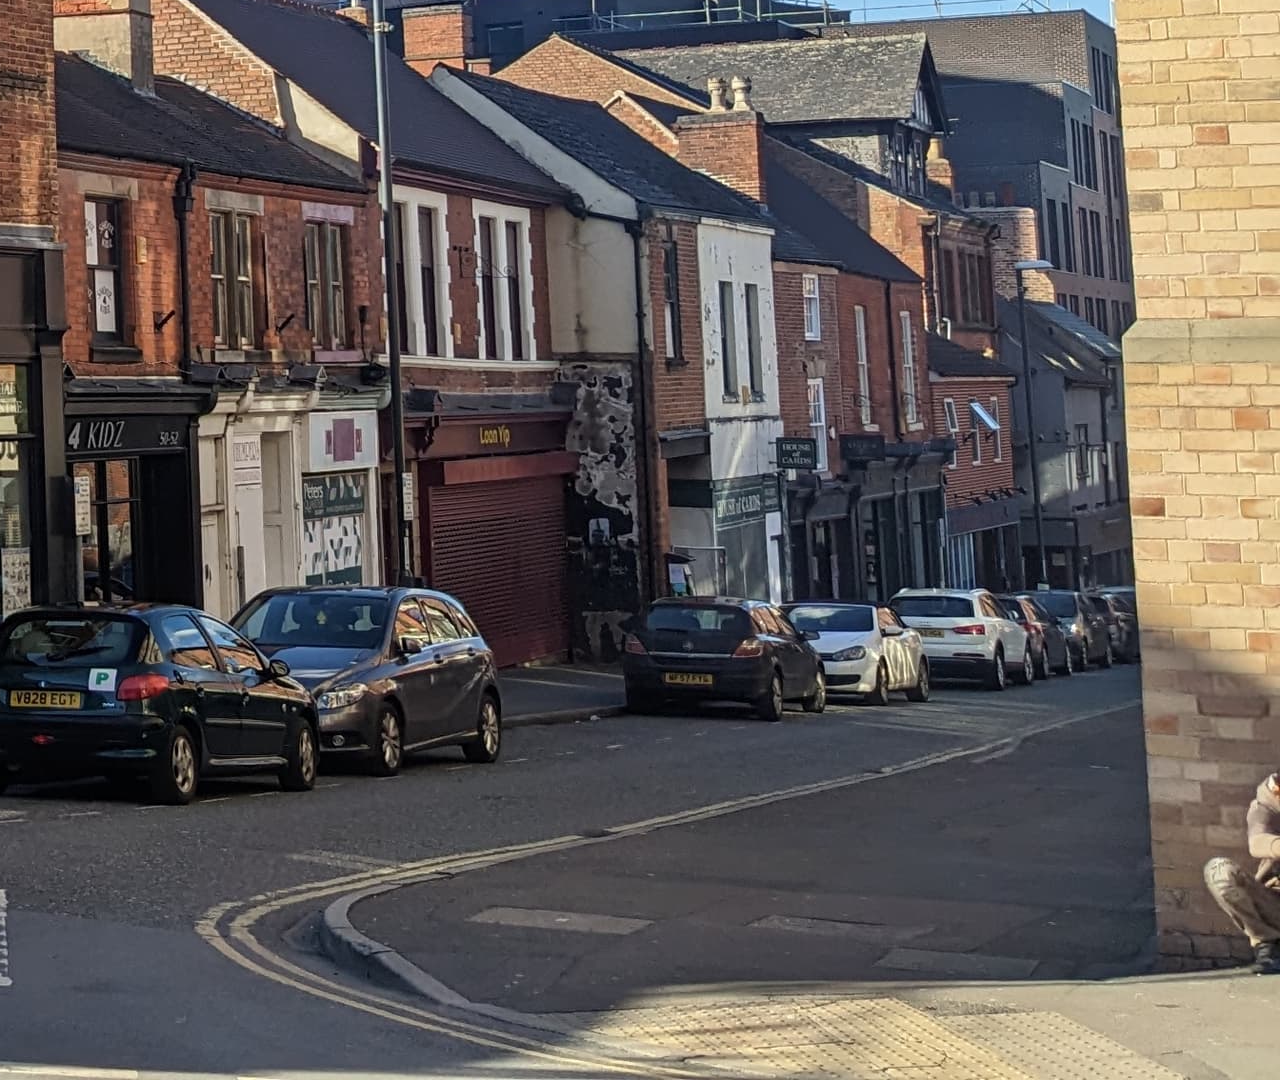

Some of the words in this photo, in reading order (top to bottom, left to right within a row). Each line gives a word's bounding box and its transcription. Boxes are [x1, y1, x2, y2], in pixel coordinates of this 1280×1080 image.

[68, 422, 80, 449] 4
[88, 421, 125, 448] KIDZ
[782, 443, 811, 451] HOUSE
[782, 457, 811, 465] CARDS
[716, 498, 735, 517] HOUSE
[742, 494, 760, 512] CARDS
[96, 672, 109, 685] P
[16, 692, 47, 705] V828
[50, 693, 74, 705] EGT
